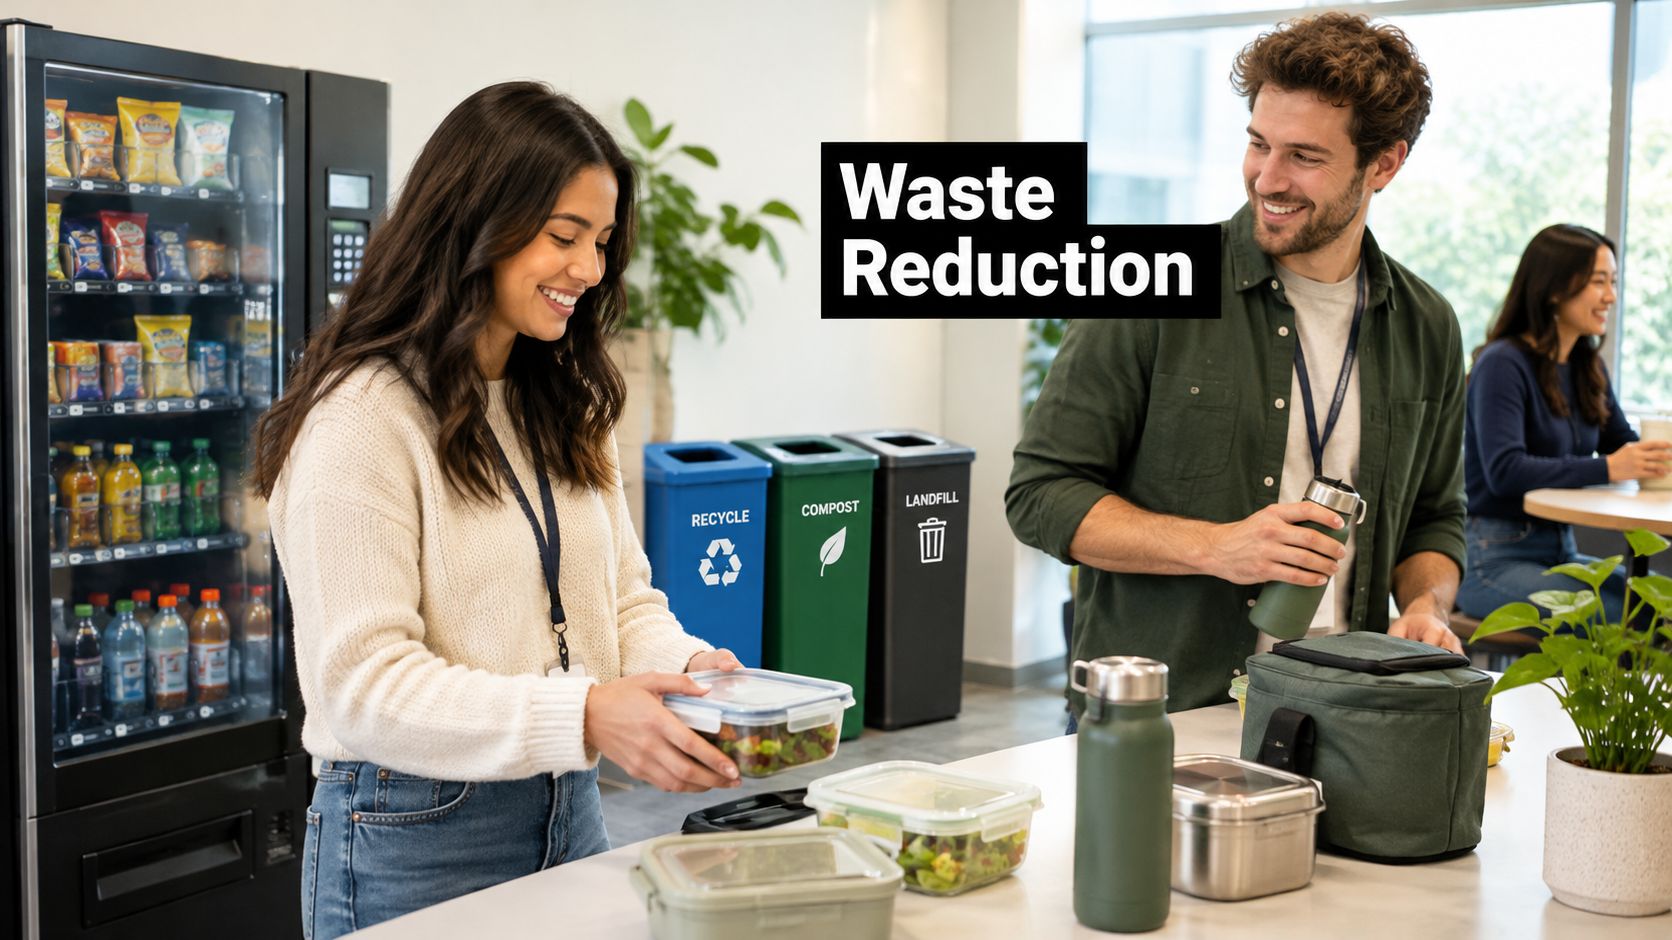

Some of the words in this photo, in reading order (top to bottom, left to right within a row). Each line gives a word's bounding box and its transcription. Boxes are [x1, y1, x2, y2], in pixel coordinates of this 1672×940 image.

[801, 499, 860, 517] COMPOST
[905, 491, 960, 508] LANDFILL
[691, 509, 750, 528] RECYCLE
